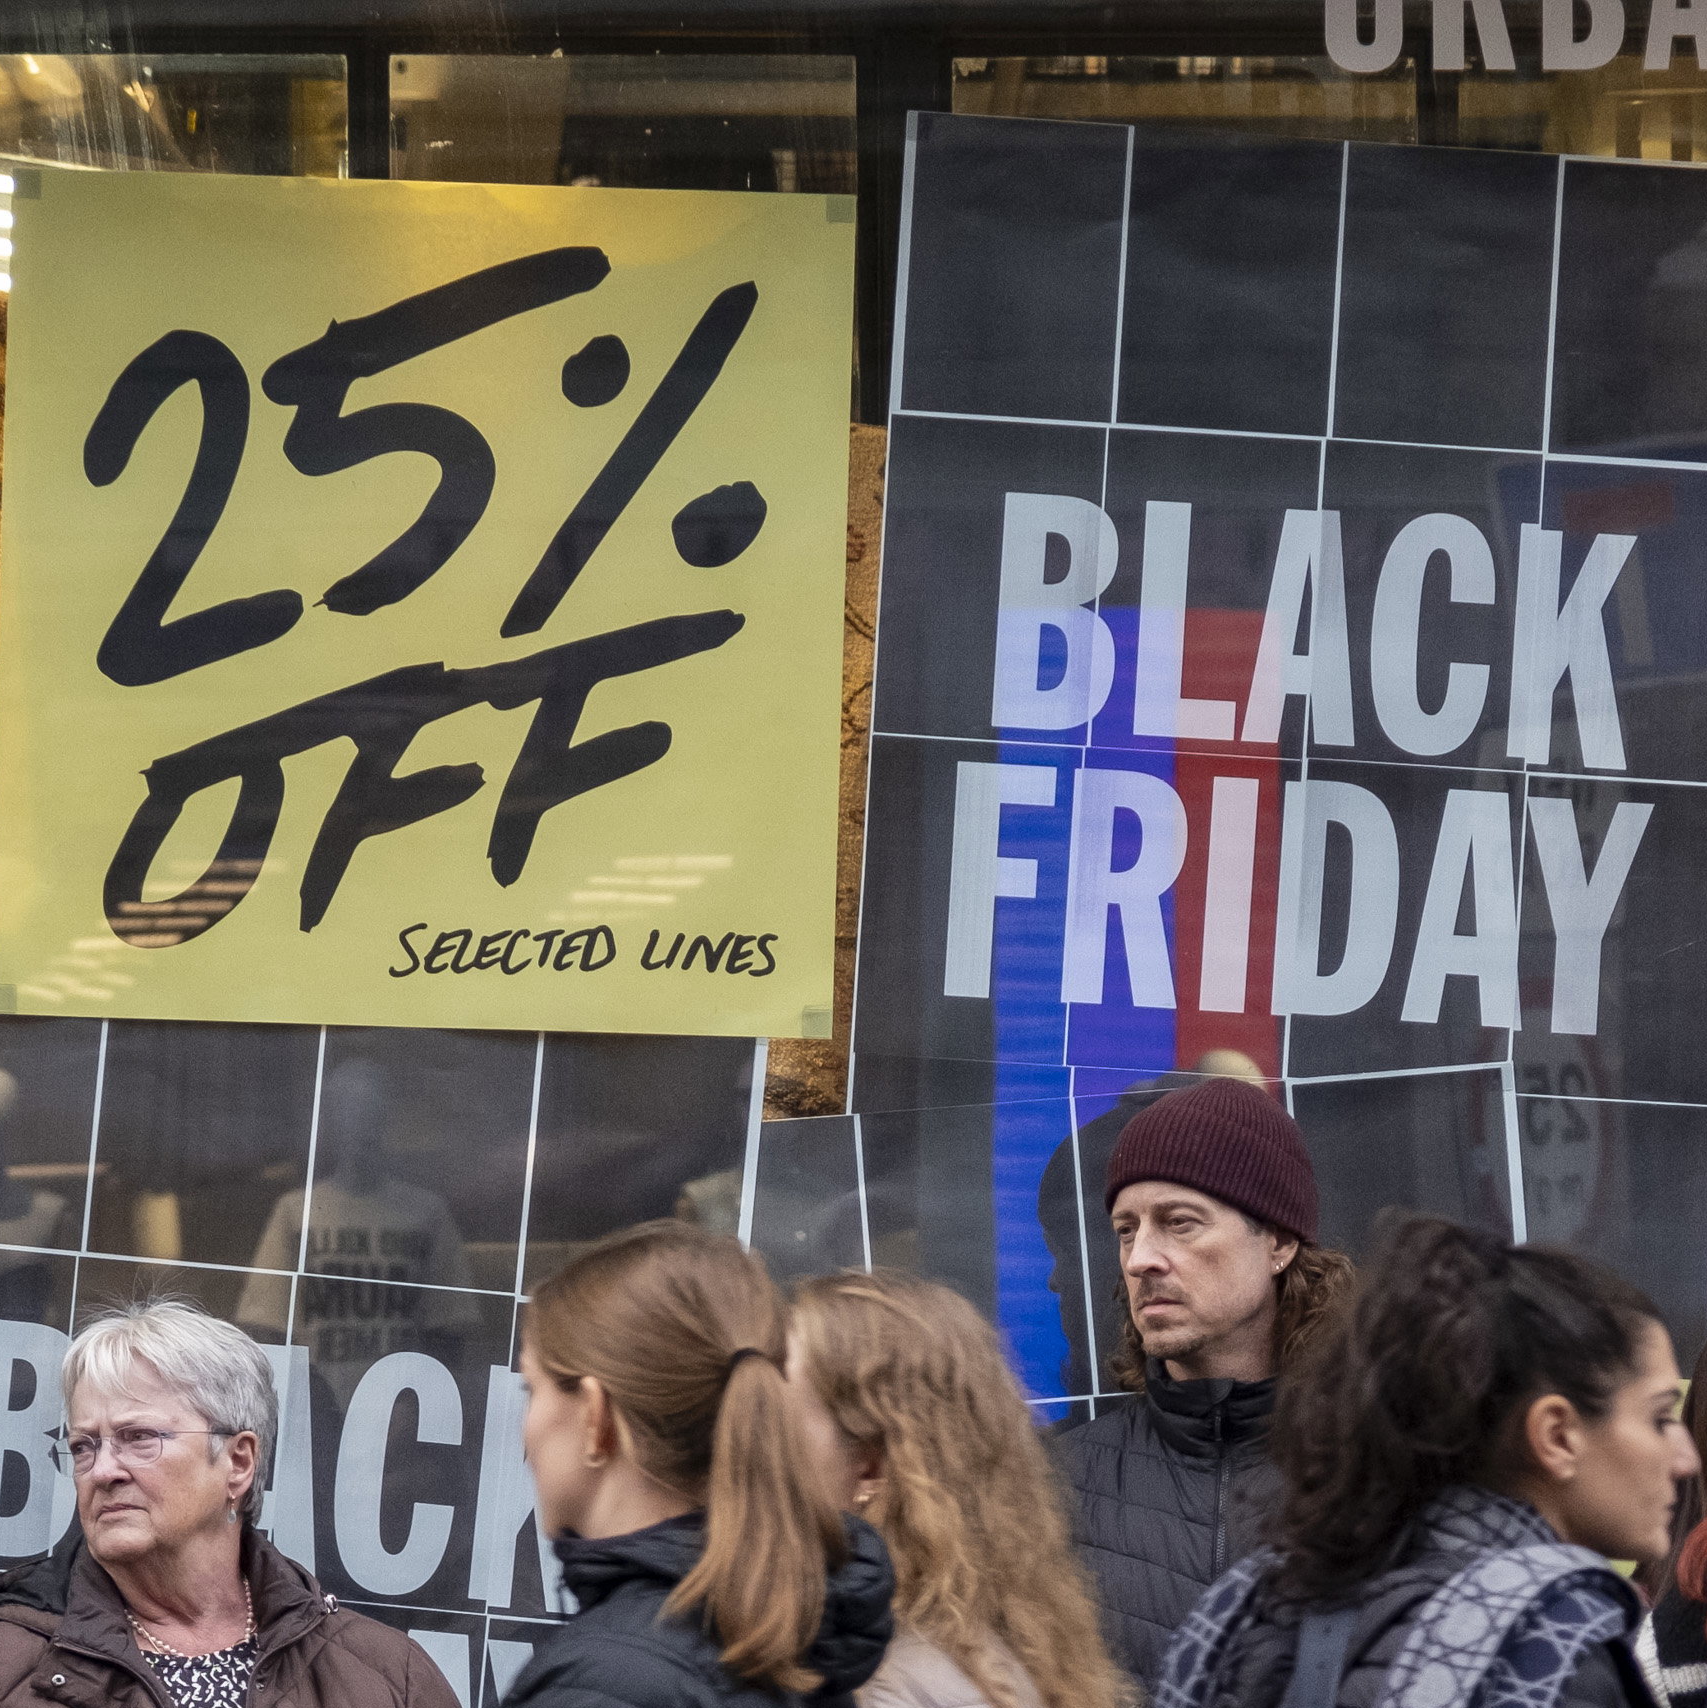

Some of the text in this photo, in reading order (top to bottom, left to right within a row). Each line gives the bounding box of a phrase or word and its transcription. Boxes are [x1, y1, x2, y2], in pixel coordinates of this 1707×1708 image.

[83, 245, 768, 688] 25%
[990, 491, 1638, 771] BLACK
[102, 608, 747, 949] OFF
[943, 759, 1656, 1036] FRIDAY
[388, 922, 780, 979] SELECTED LINES
